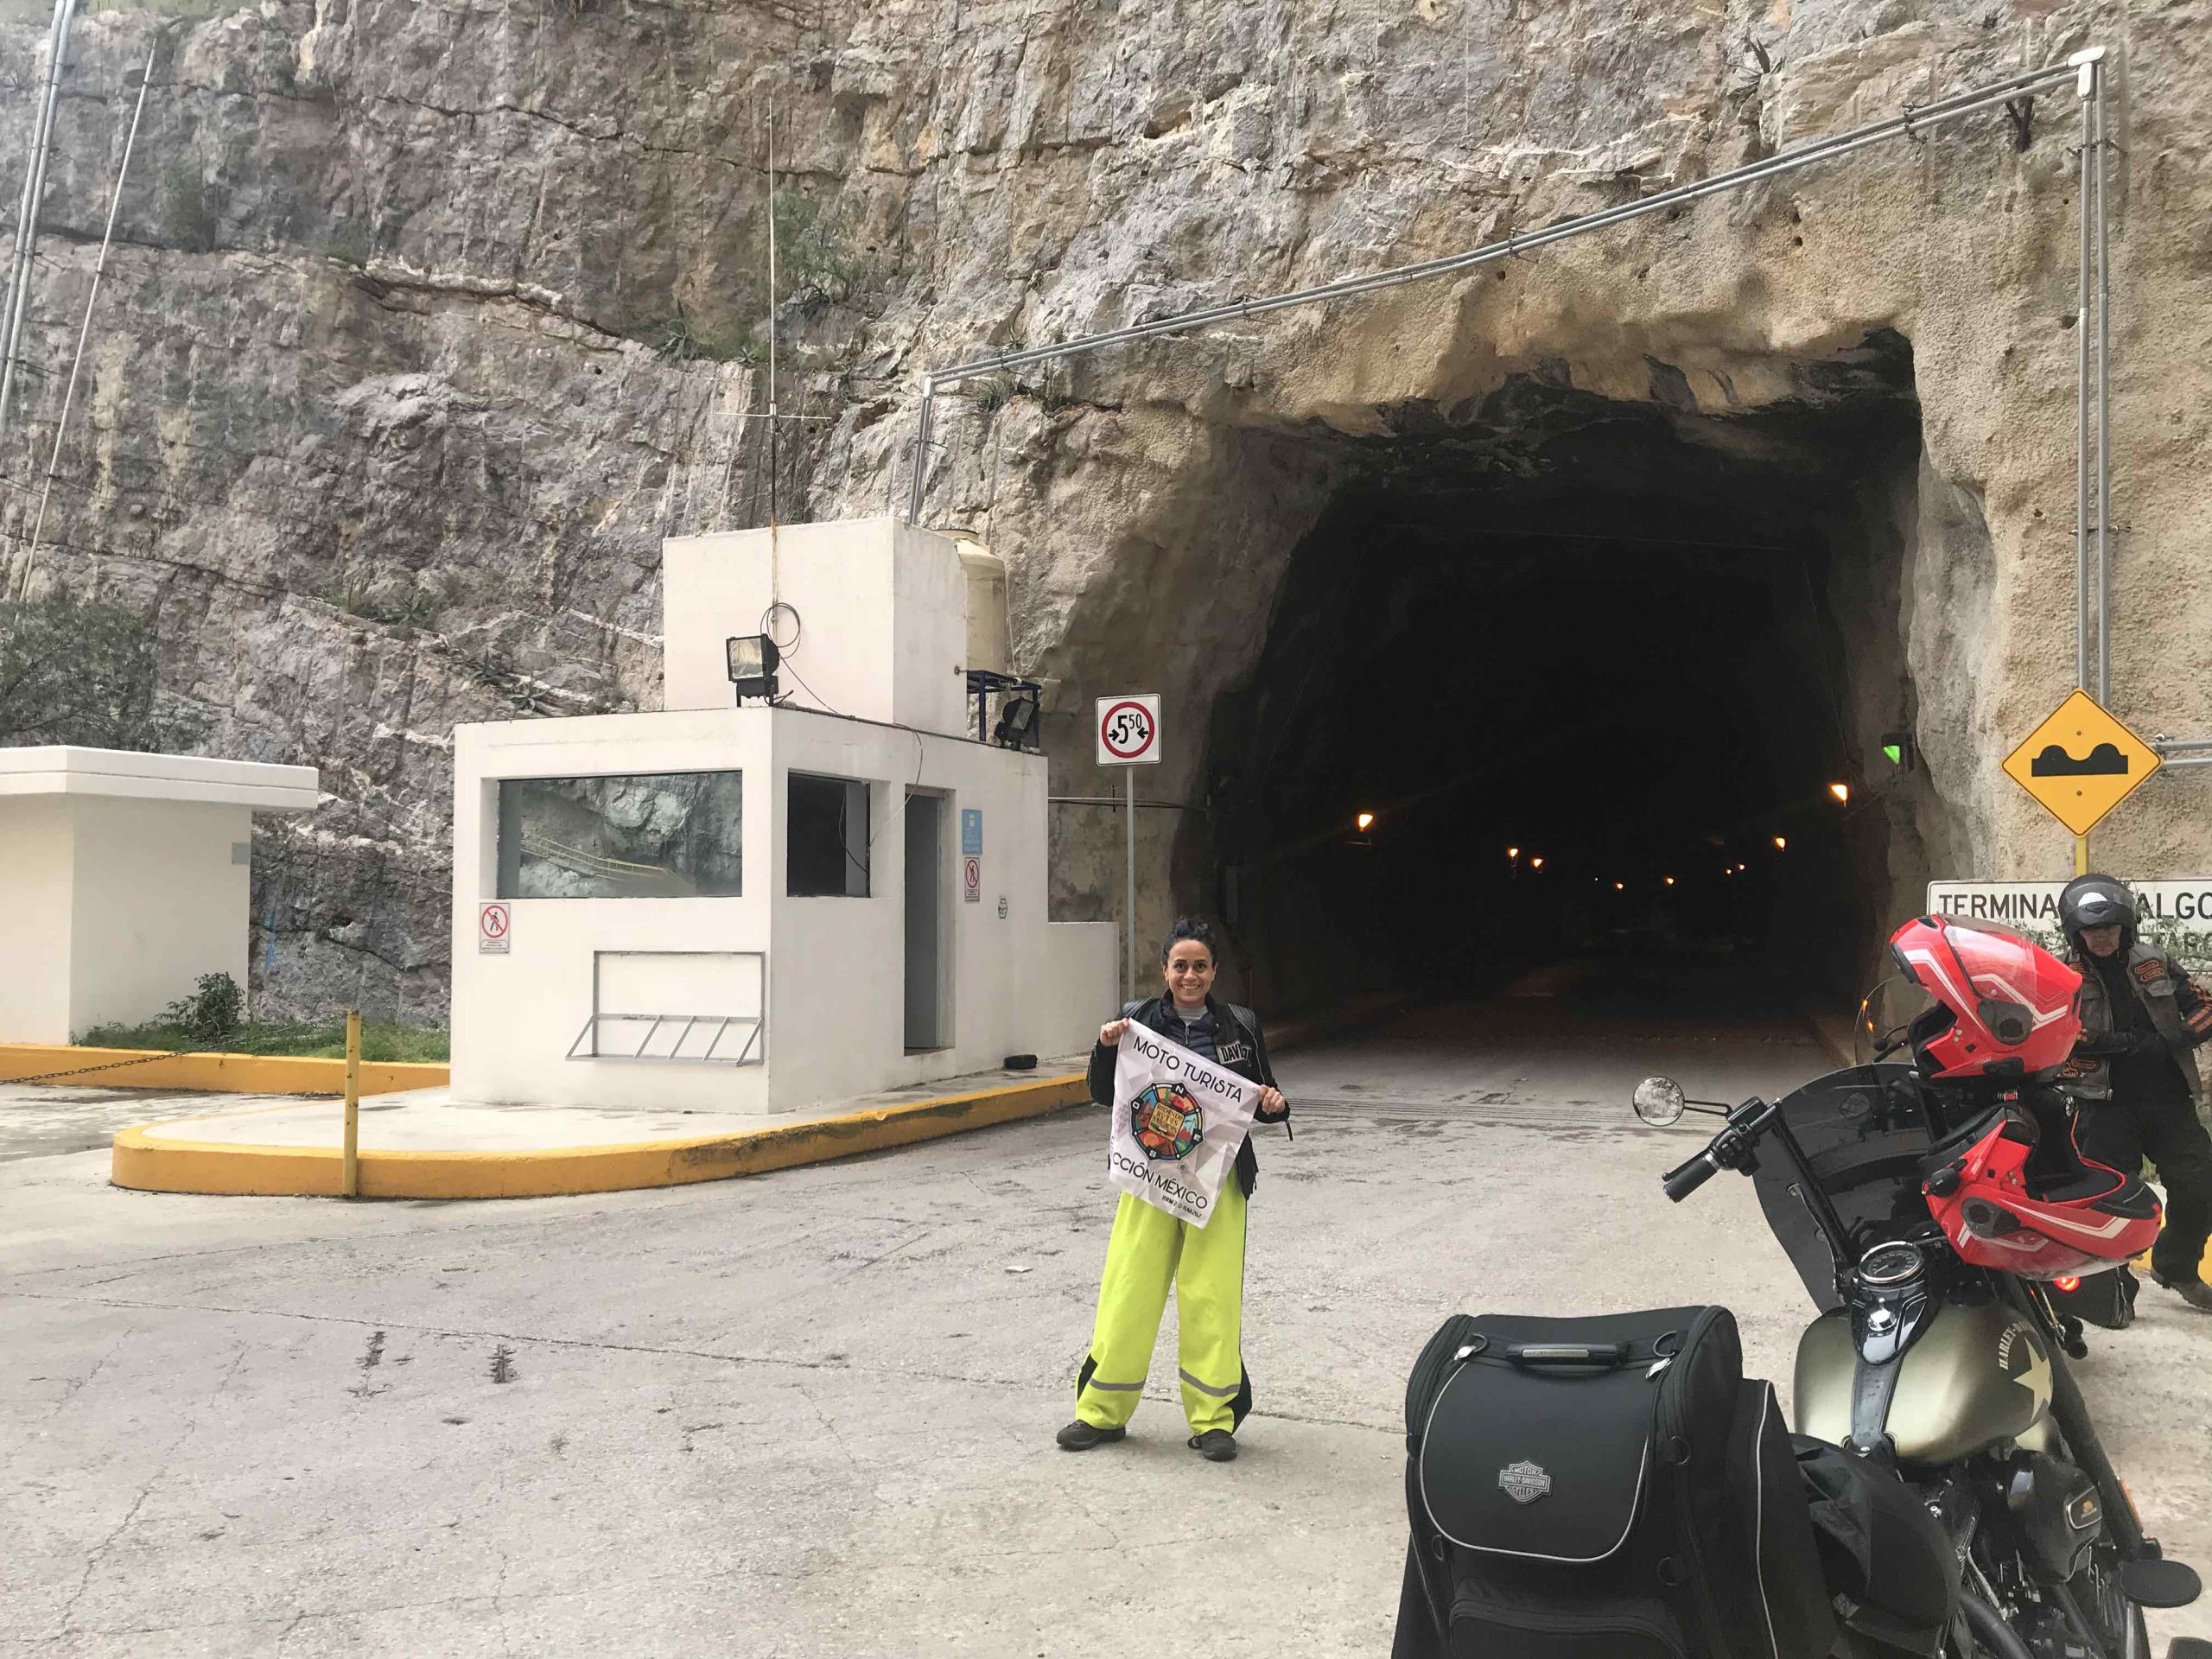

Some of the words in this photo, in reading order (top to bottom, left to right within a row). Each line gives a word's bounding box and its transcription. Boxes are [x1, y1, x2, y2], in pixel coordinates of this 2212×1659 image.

[1938, 893, 2060, 920] TERMINA
[2135, 892, 2212, 920] ALGO
[1133, 1035, 1180, 1071] MOTO
[1183, 1061, 1243, 1103] TURISTA
[1175, 1085, 1185, 1094] N
[1154, 1175, 1208, 1210] MÉXICO
